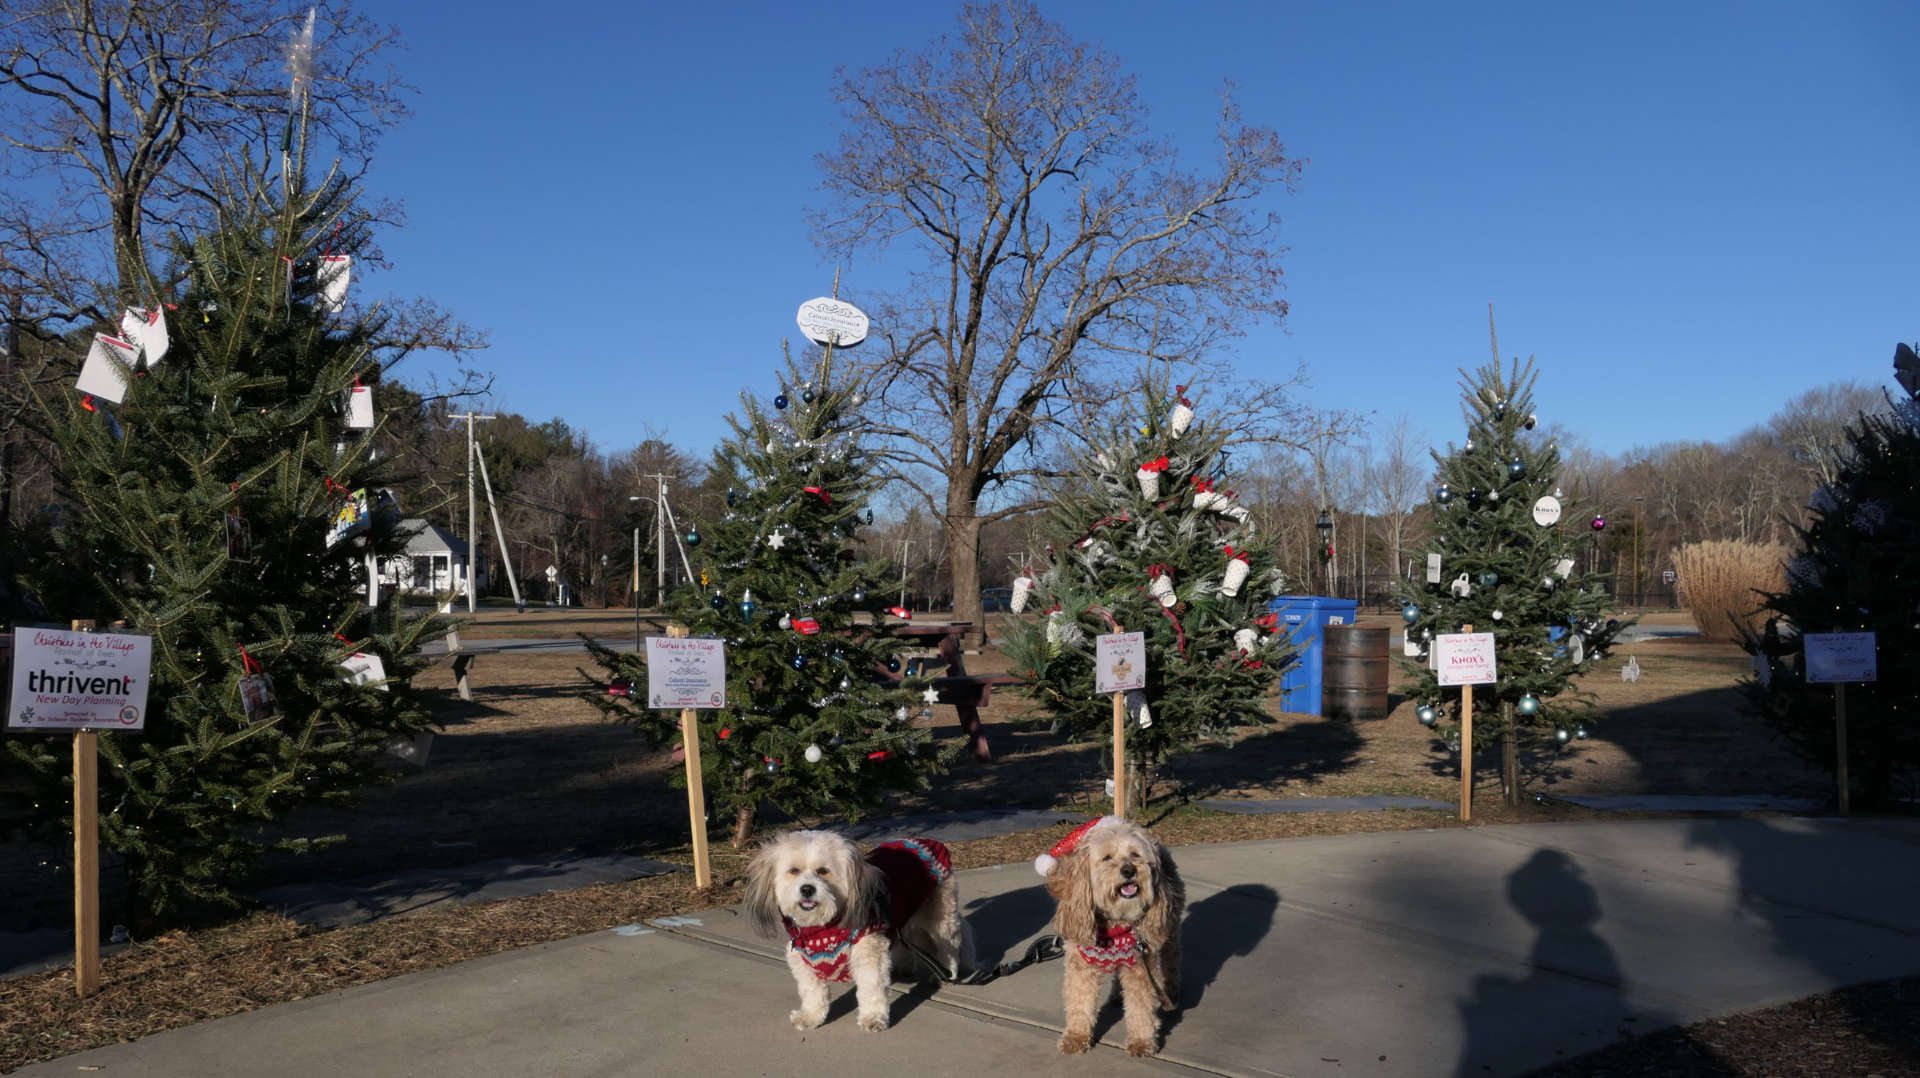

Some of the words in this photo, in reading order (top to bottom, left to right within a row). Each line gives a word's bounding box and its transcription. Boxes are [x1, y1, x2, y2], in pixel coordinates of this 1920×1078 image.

[34, 632, 73, 648] Christmas
[77, 637, 87, 648] in
[90, 637, 104, 649] the
[105, 635, 136, 656] Village
[28, 669, 132, 695] thrivent
[35, 695, 60, 704] New
[62, 695, 81, 705] Day
[84, 696, 127, 706] Planning
